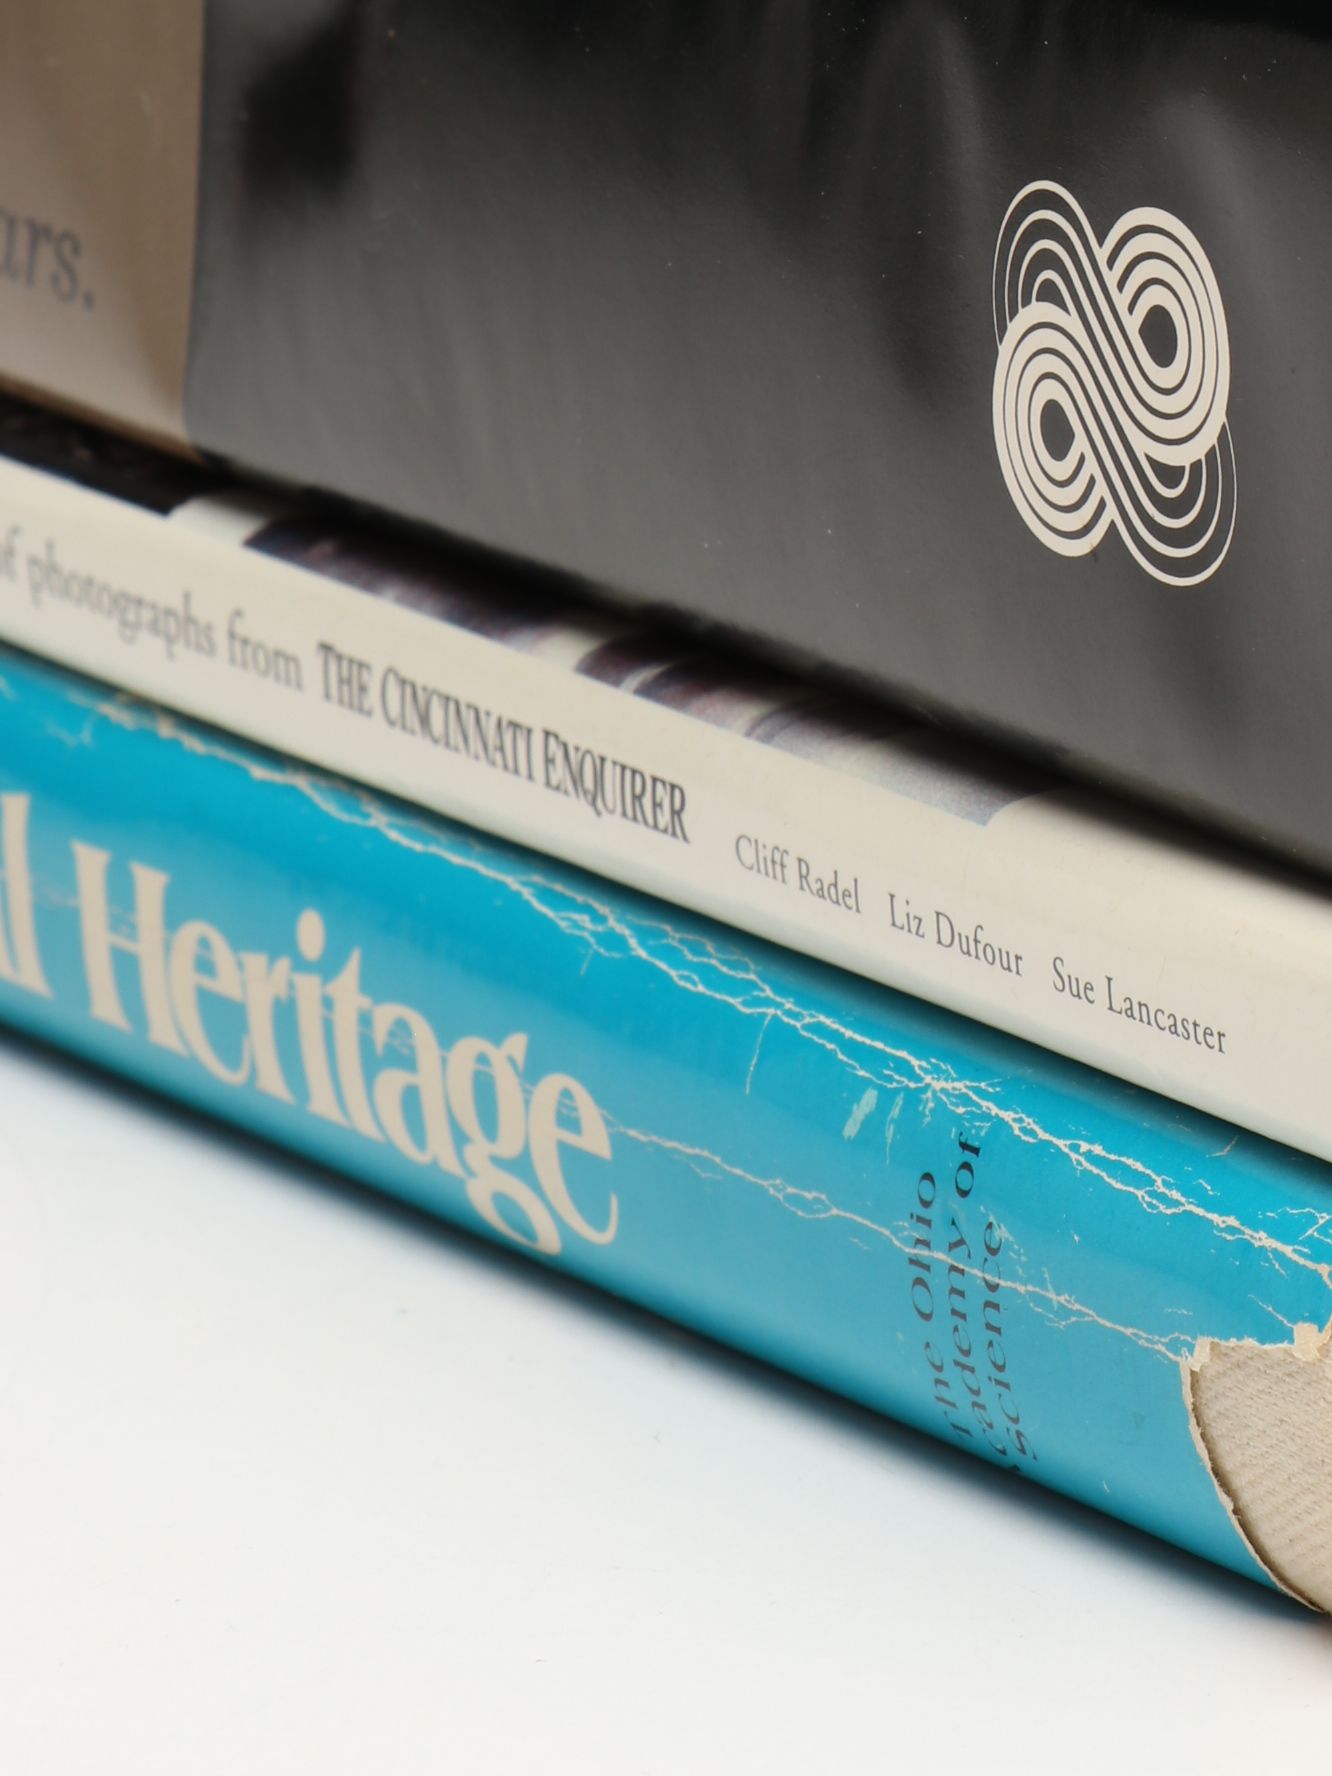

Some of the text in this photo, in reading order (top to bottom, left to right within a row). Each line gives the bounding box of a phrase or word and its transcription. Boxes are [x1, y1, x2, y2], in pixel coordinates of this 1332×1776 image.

[26, 538, 217, 662] photographs
[227, 608, 305, 693] from
[317, 641, 374, 718] THE
[381, 666, 536, 783] CINCINNATI
[543, 729, 691, 845] ENQUIRER
[735, 833, 789, 886] Cliff
[797, 855, 863, 915] Radel
[888, 892, 926, 939] Liz
[935, 910, 1024, 977] Dufour
[1051, 956, 1096, 1005] Sue
[1106, 975, 1227, 1055] Lancaster
[70, 837, 619, 1256] Heritage
[907, 1171, 936, 1323] Ohio
[946, 1130, 1020, 1471] cademy of
